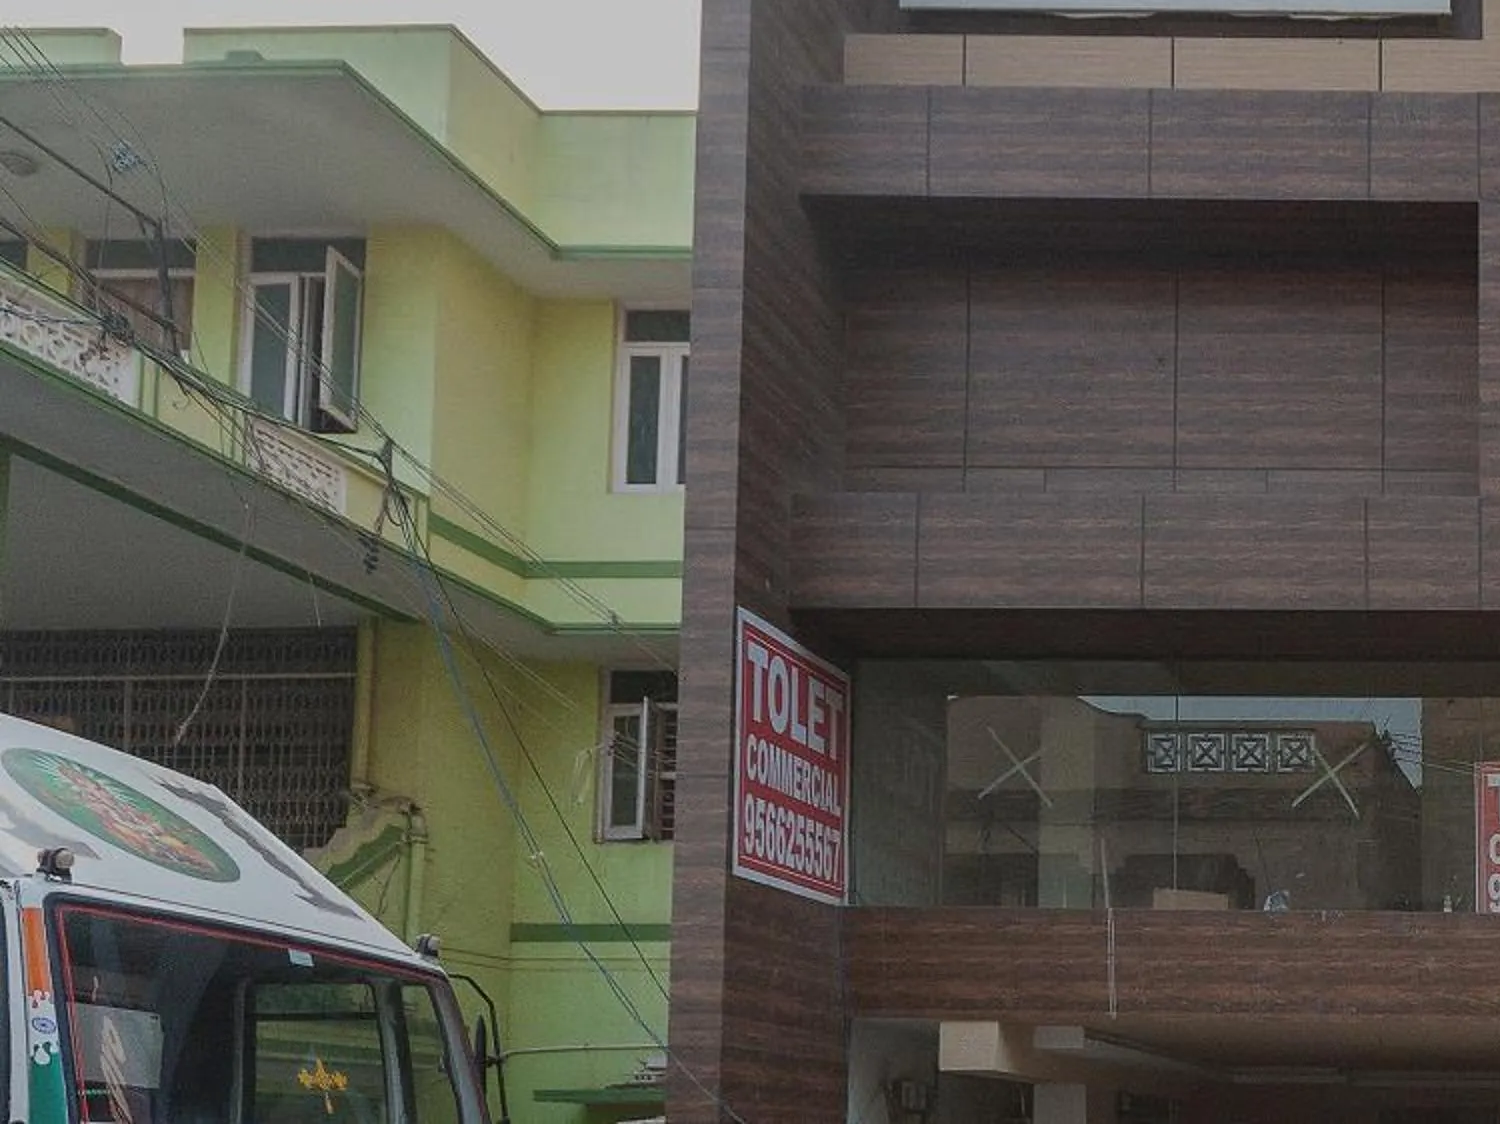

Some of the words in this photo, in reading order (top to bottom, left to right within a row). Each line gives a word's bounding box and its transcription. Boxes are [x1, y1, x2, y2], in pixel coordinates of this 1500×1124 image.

[747, 639, 844, 760] TOLET
[747, 733, 841, 817] COMMERCIAL
[744, 793, 841, 882] 9566255567
